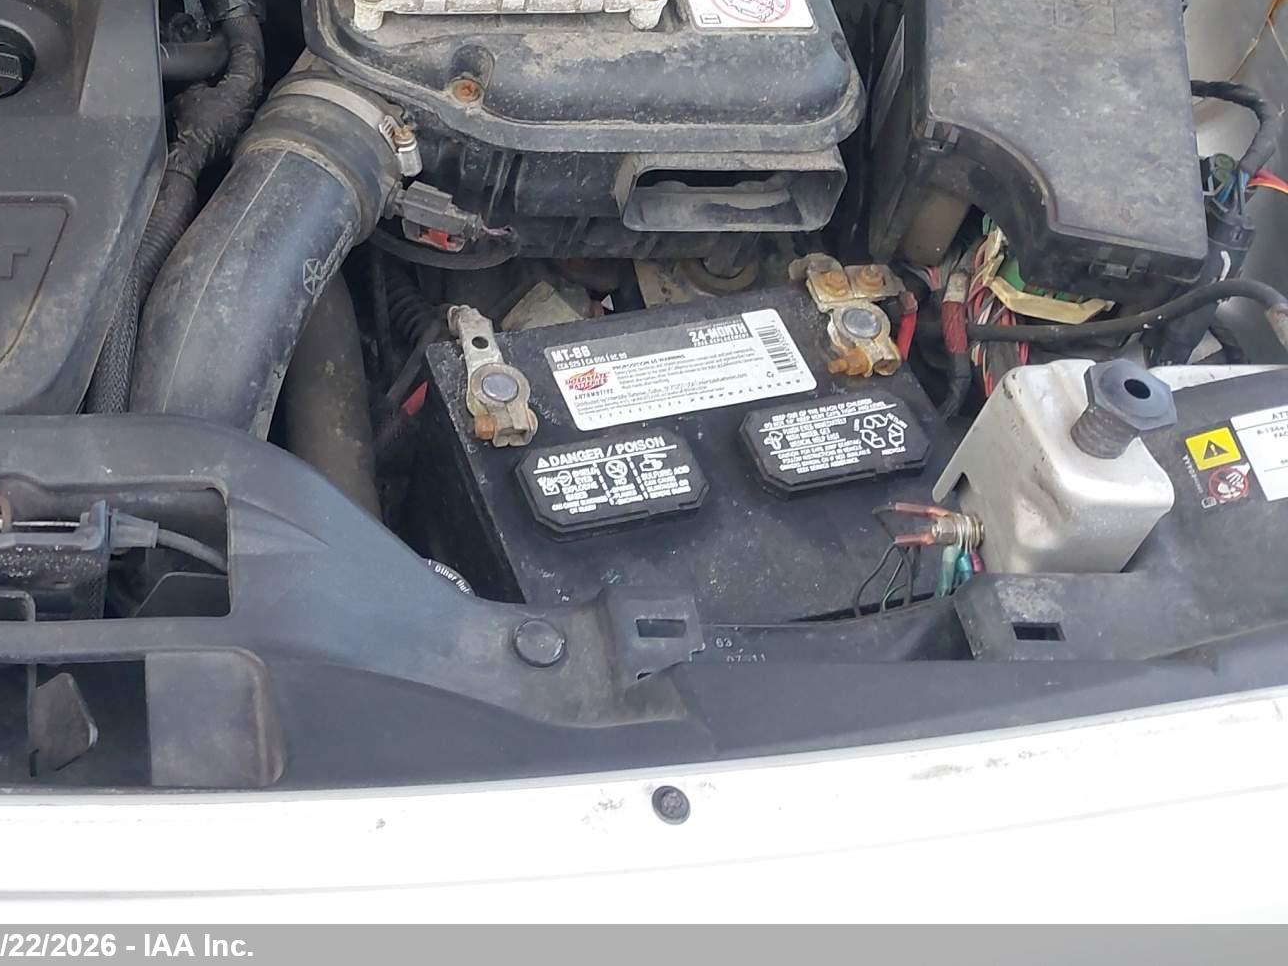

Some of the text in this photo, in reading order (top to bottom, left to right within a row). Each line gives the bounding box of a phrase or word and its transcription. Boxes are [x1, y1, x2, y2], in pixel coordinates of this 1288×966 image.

[688, 322, 748, 344] 24-MONTH
[549, 436, 666, 468] DANGER / POISON
